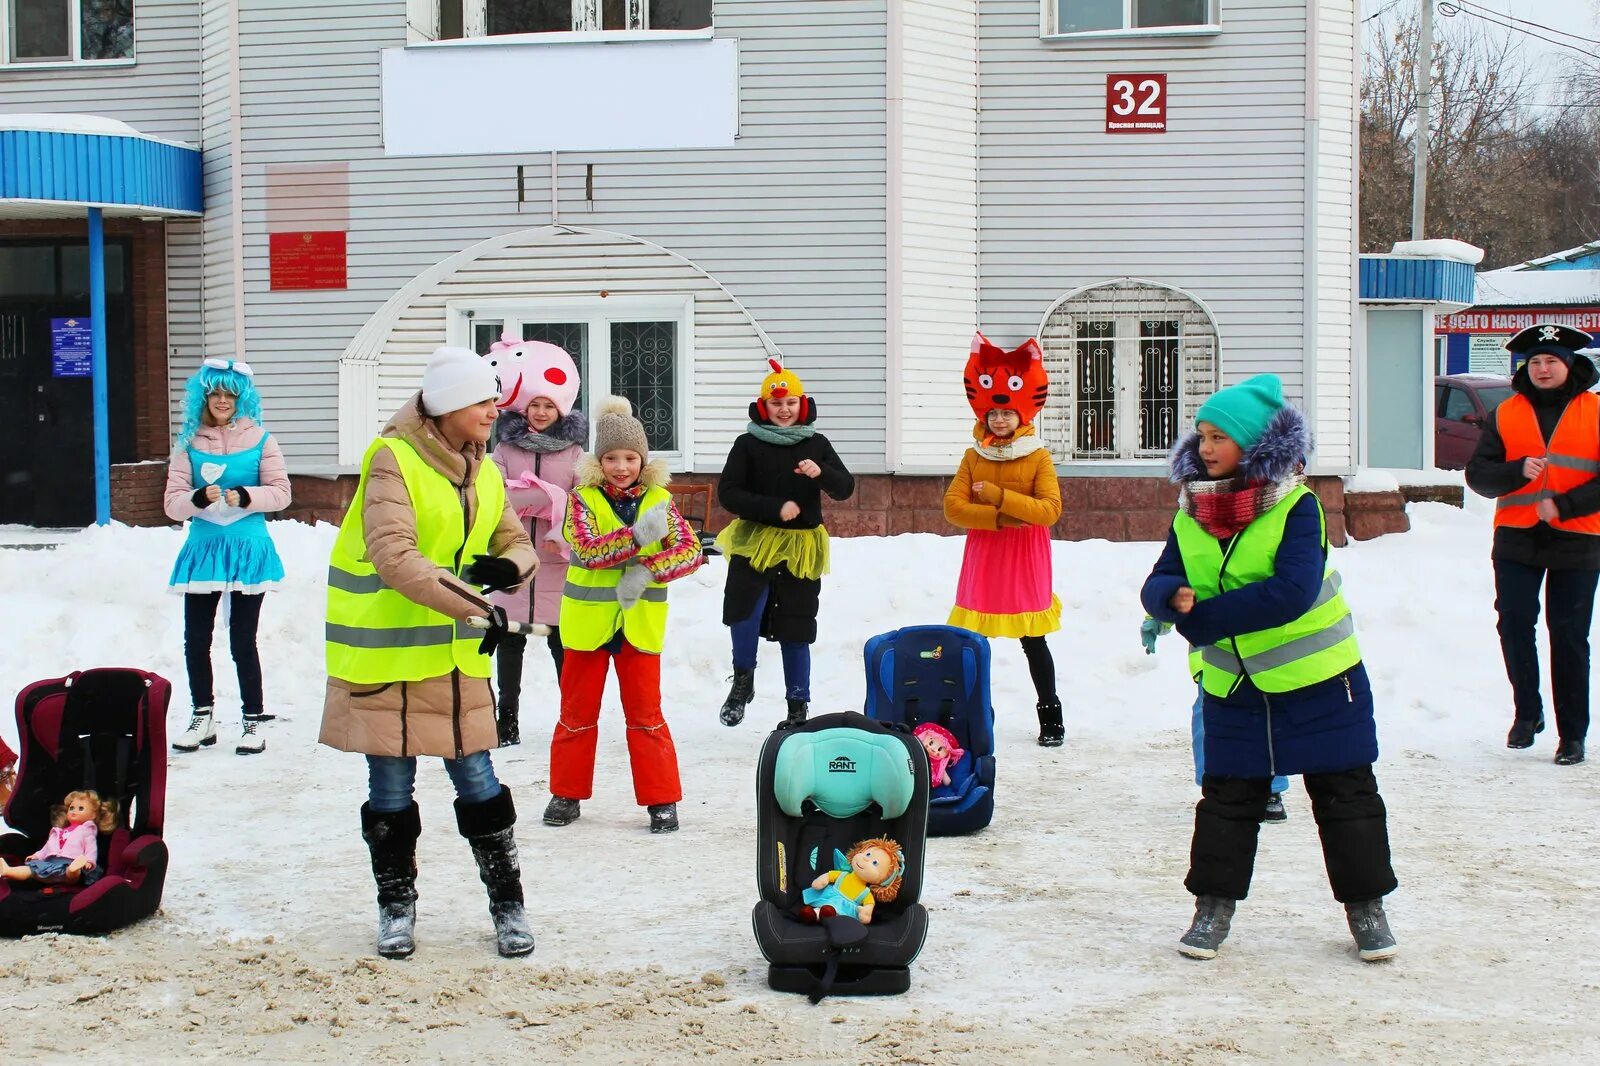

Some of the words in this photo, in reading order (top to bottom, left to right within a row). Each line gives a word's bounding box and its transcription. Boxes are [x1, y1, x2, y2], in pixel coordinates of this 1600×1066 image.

[1112, 79, 1161, 116] 32
[1108, 121, 1135, 129] Красная
[1449, 313, 1489, 329] ОСАГО
[1491, 313, 1533, 329] КАСКО
[1535, 312, 1600, 328] ИМУЩЕСТ
[828, 761, 857, 770] RANT
